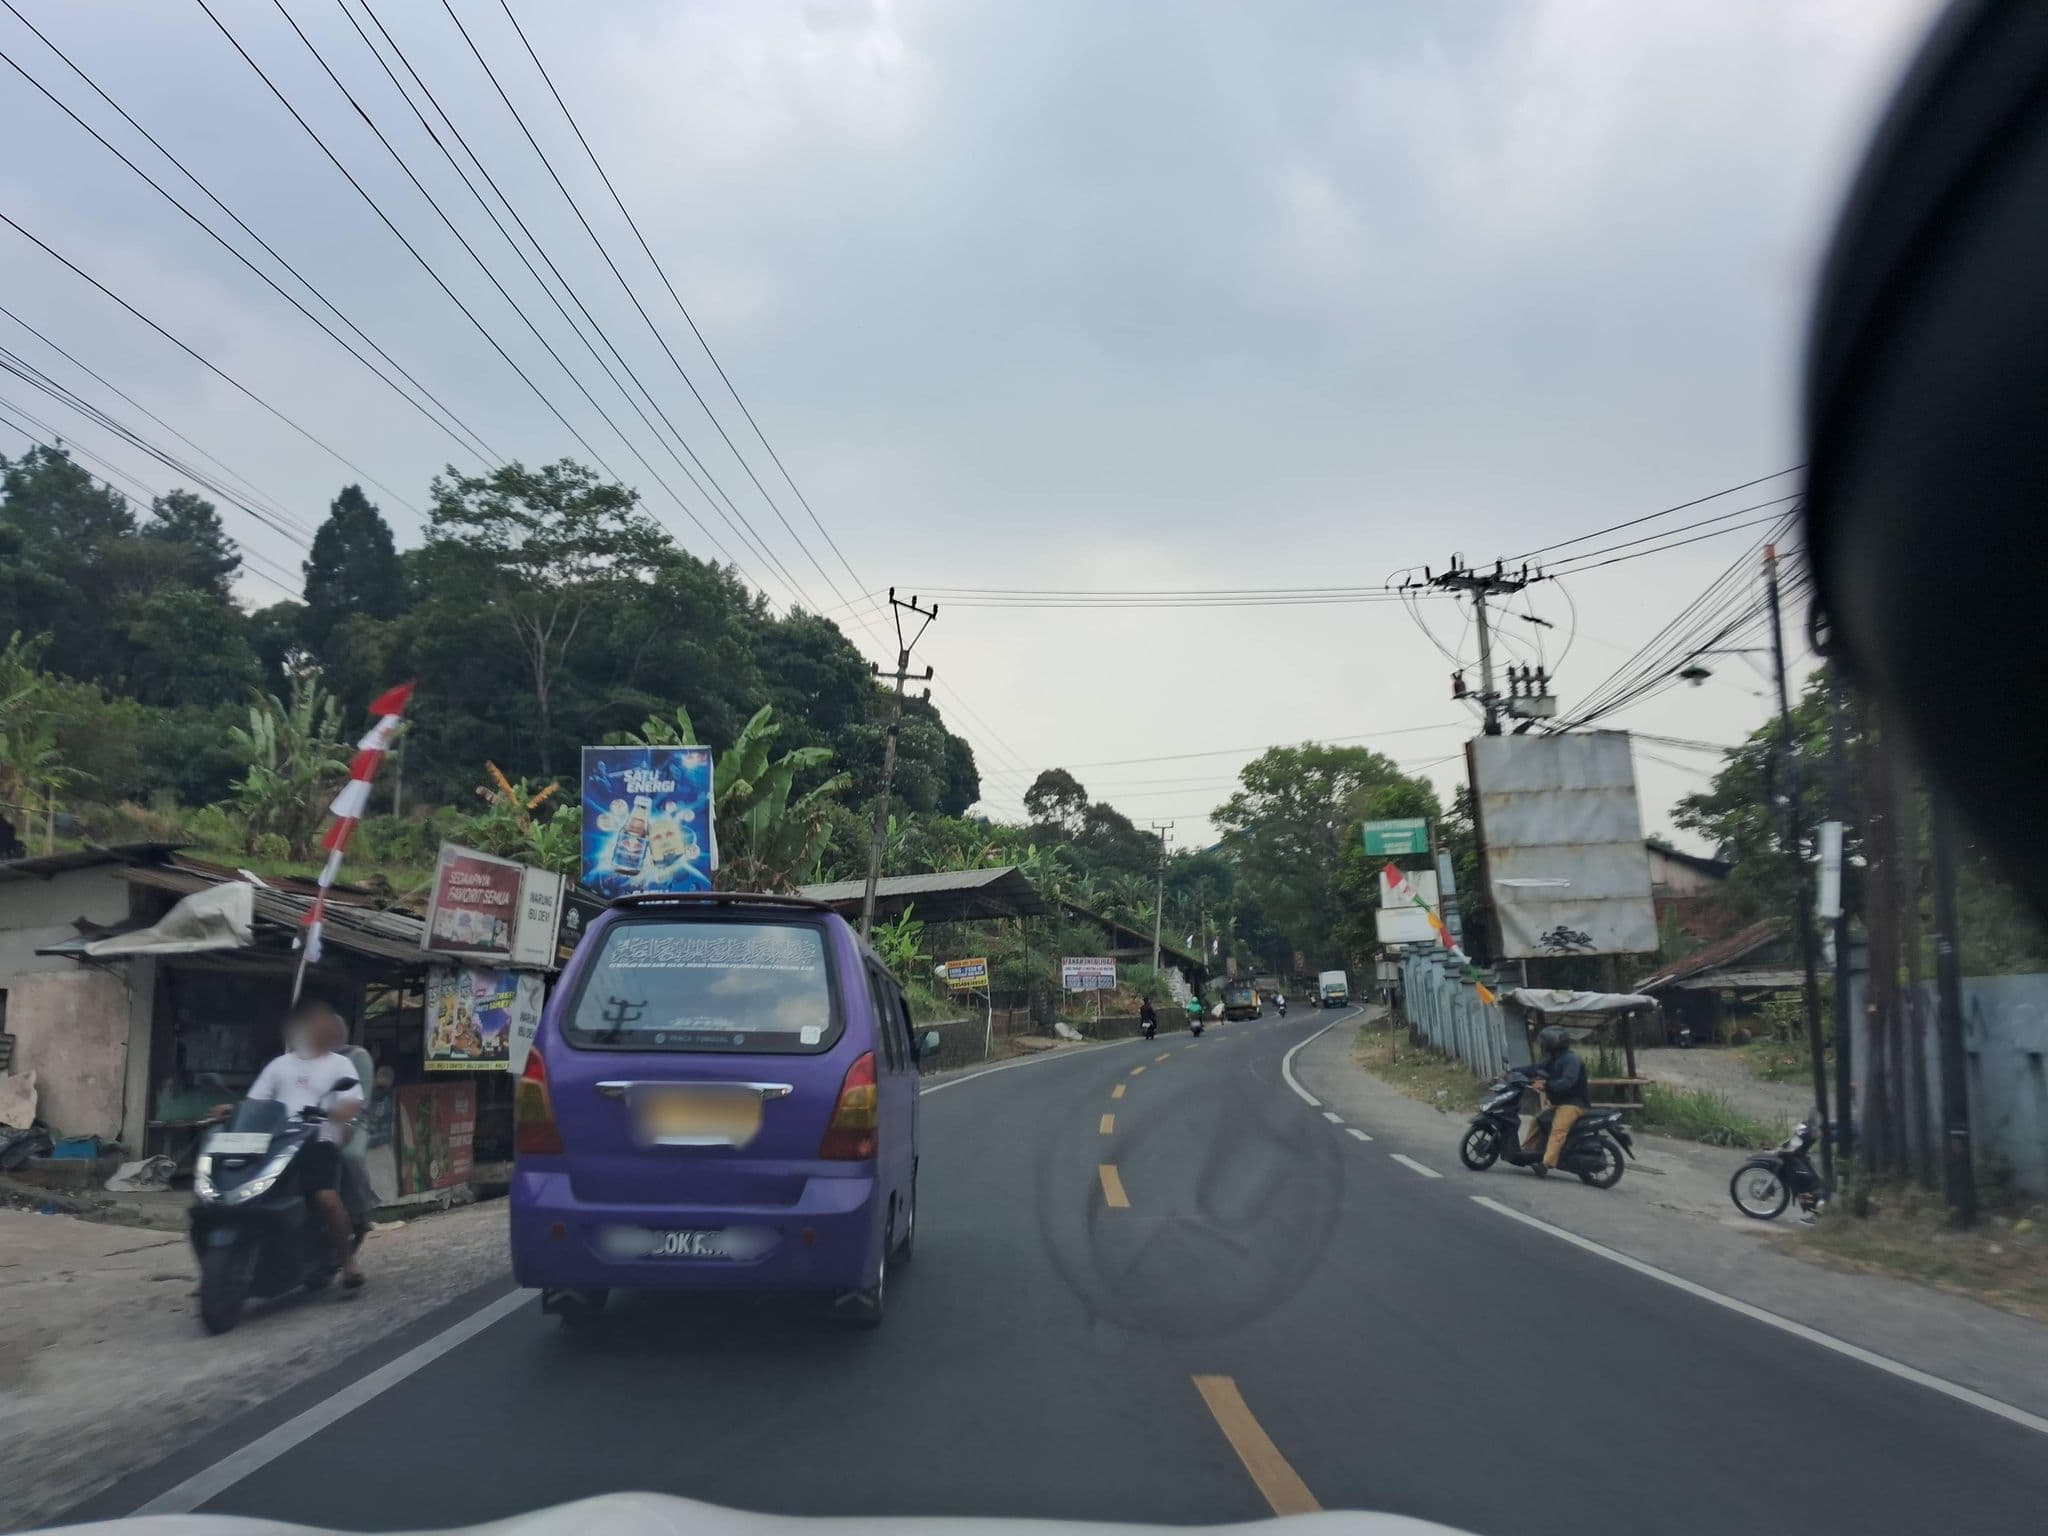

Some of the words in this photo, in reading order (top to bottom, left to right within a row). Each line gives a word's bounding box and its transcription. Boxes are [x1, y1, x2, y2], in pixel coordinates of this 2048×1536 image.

[624, 769, 660, 783] SATU
[626, 780, 676, 793] ENERGI
[483, 888, 510, 905] SEMUA
